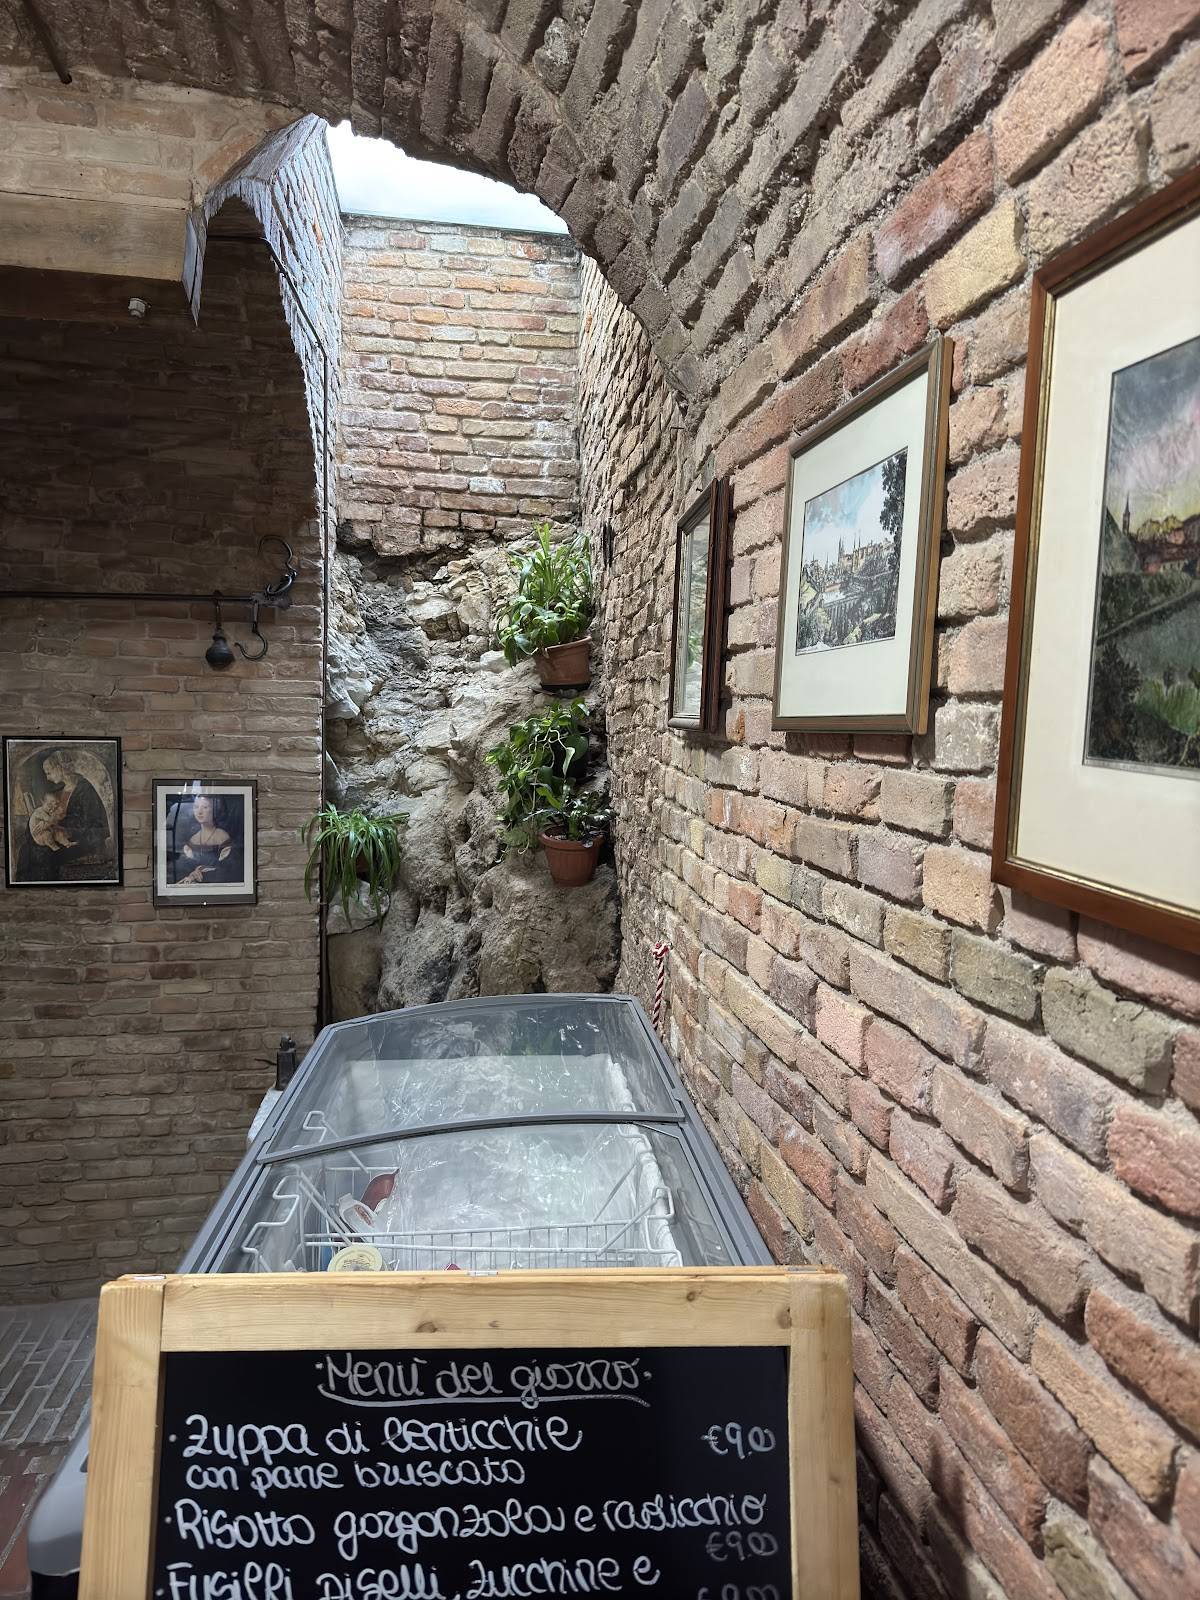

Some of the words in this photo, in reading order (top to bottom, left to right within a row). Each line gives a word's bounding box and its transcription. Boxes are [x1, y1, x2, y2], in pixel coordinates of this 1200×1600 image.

[436, 1361, 503, 1399] del
[510, 1357, 641, 1409] giorno
[183, 1414, 319, 1466] Zuppa
[326, 1421, 370, 1455] di
[382, 1416, 583, 1453] lenticchie
[186, 1464, 239, 1491] con
[250, 1463, 344, 1499] pane
[355, 1456, 526, 1488] bruscato
[174, 1498, 315, 1549] Risotto
[334, 1498, 566, 1561] gorgonzola
[574, 1505, 597, 1532] e
[601, 1494, 767, 1532] radicchio
[632, 1556, 661, 1586] e
